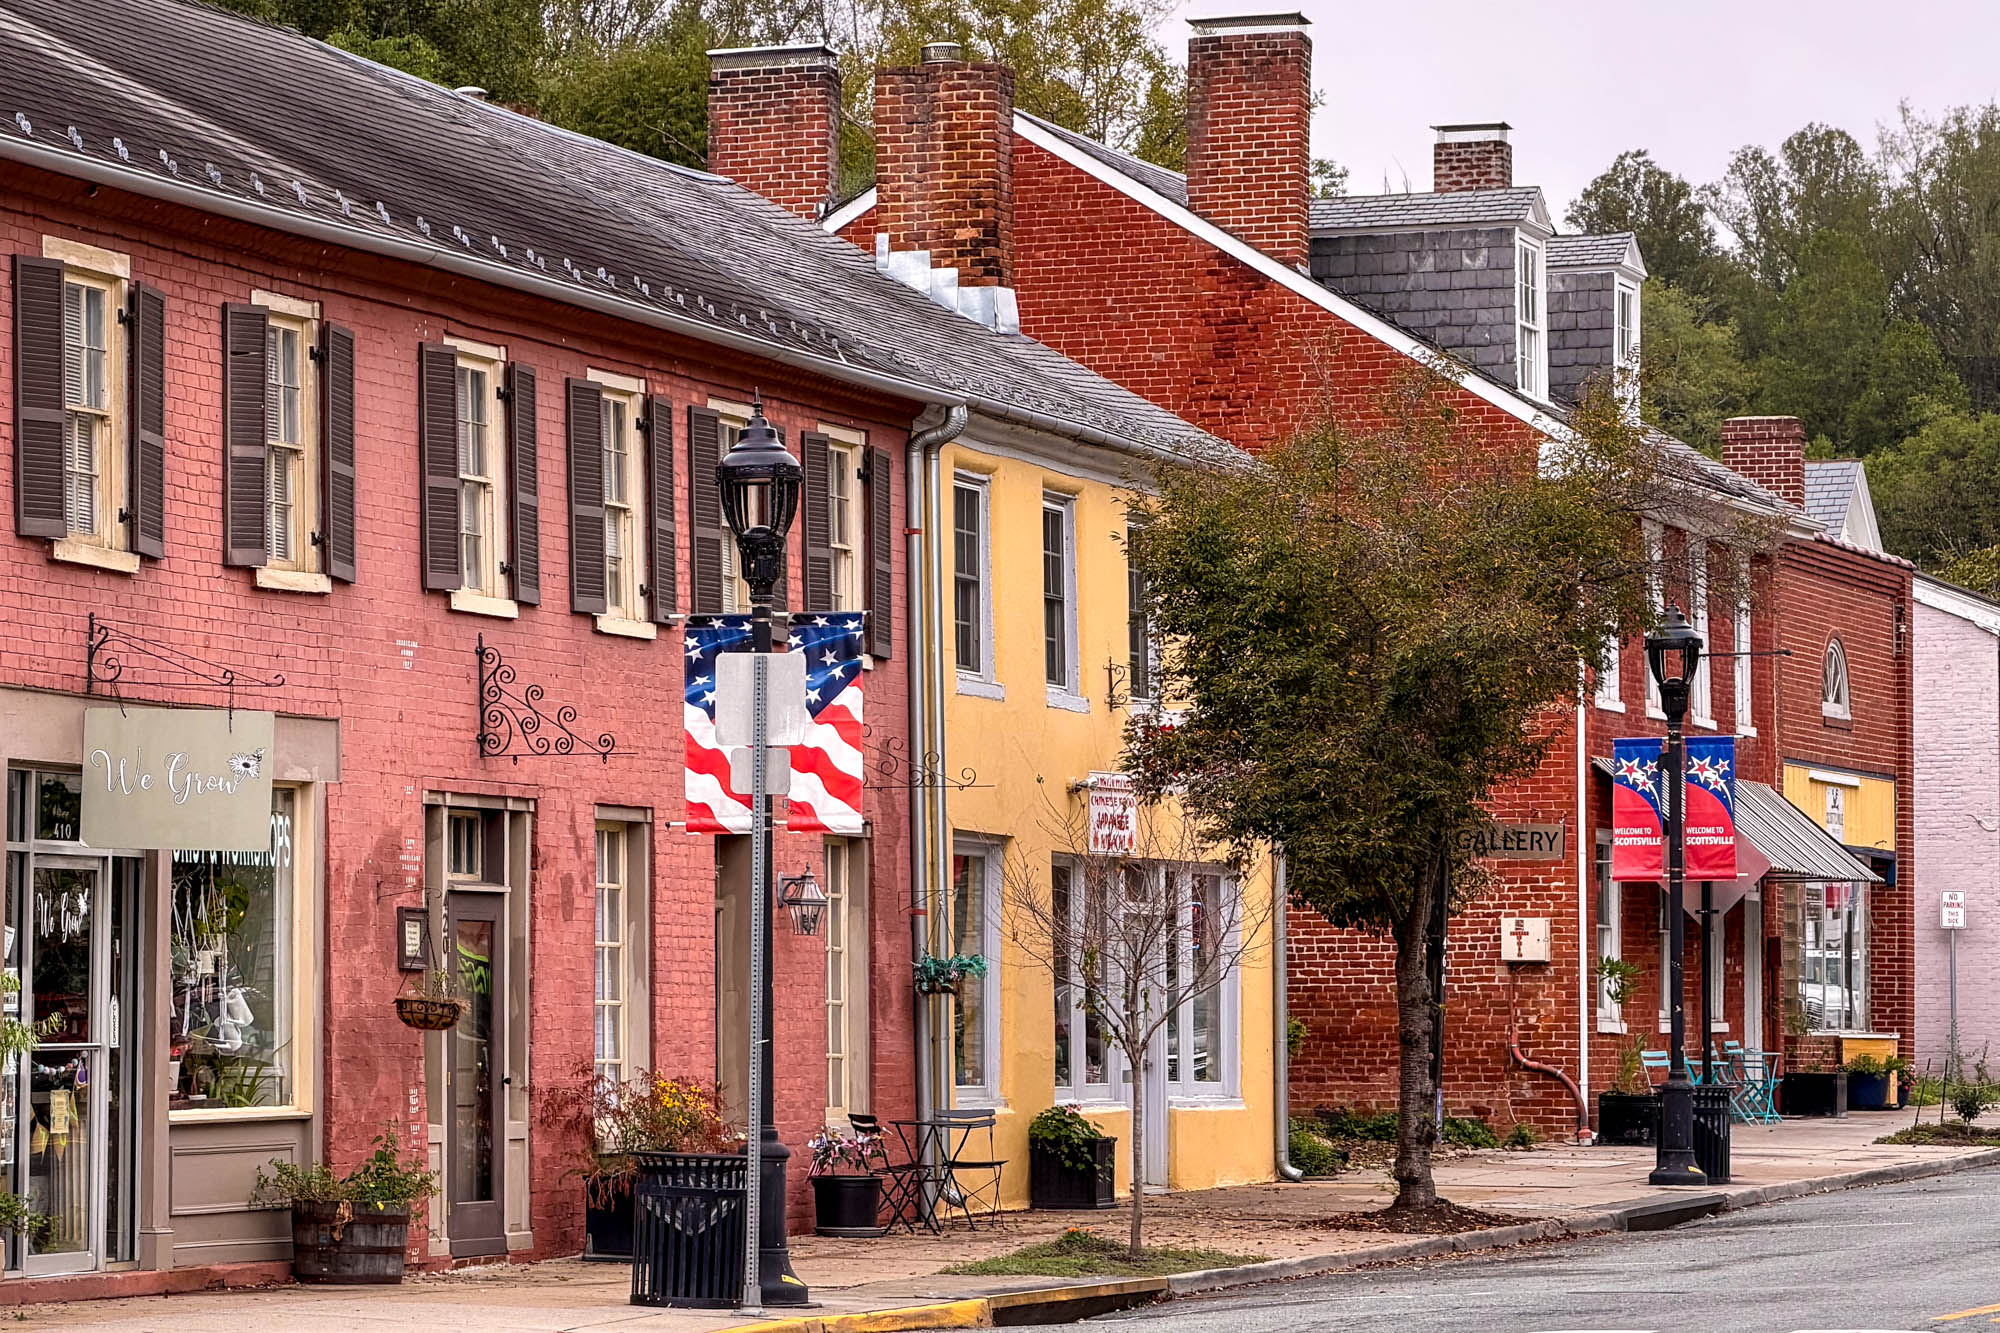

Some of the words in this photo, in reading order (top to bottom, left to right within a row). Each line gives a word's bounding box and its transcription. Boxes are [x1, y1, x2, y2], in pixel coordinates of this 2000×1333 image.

[91, 746, 154, 795] We
[164, 752, 239, 805] Grow
[54, 823, 72, 839] 410
[1614, 827, 1643, 835] WELCOME
[1643, 827, 1652, 835] TO
[1686, 826, 1715, 834] WELCOME
[1715, 826, 1724, 834] TO
[1614, 837, 1661, 846] SCOTTSVILLE
[1686, 836, 1734, 845] SCOTTSVILLE
[1943, 901, 1963, 909] PARKING
[37, 889, 55, 938] We
[61, 891, 83, 943] Grow
